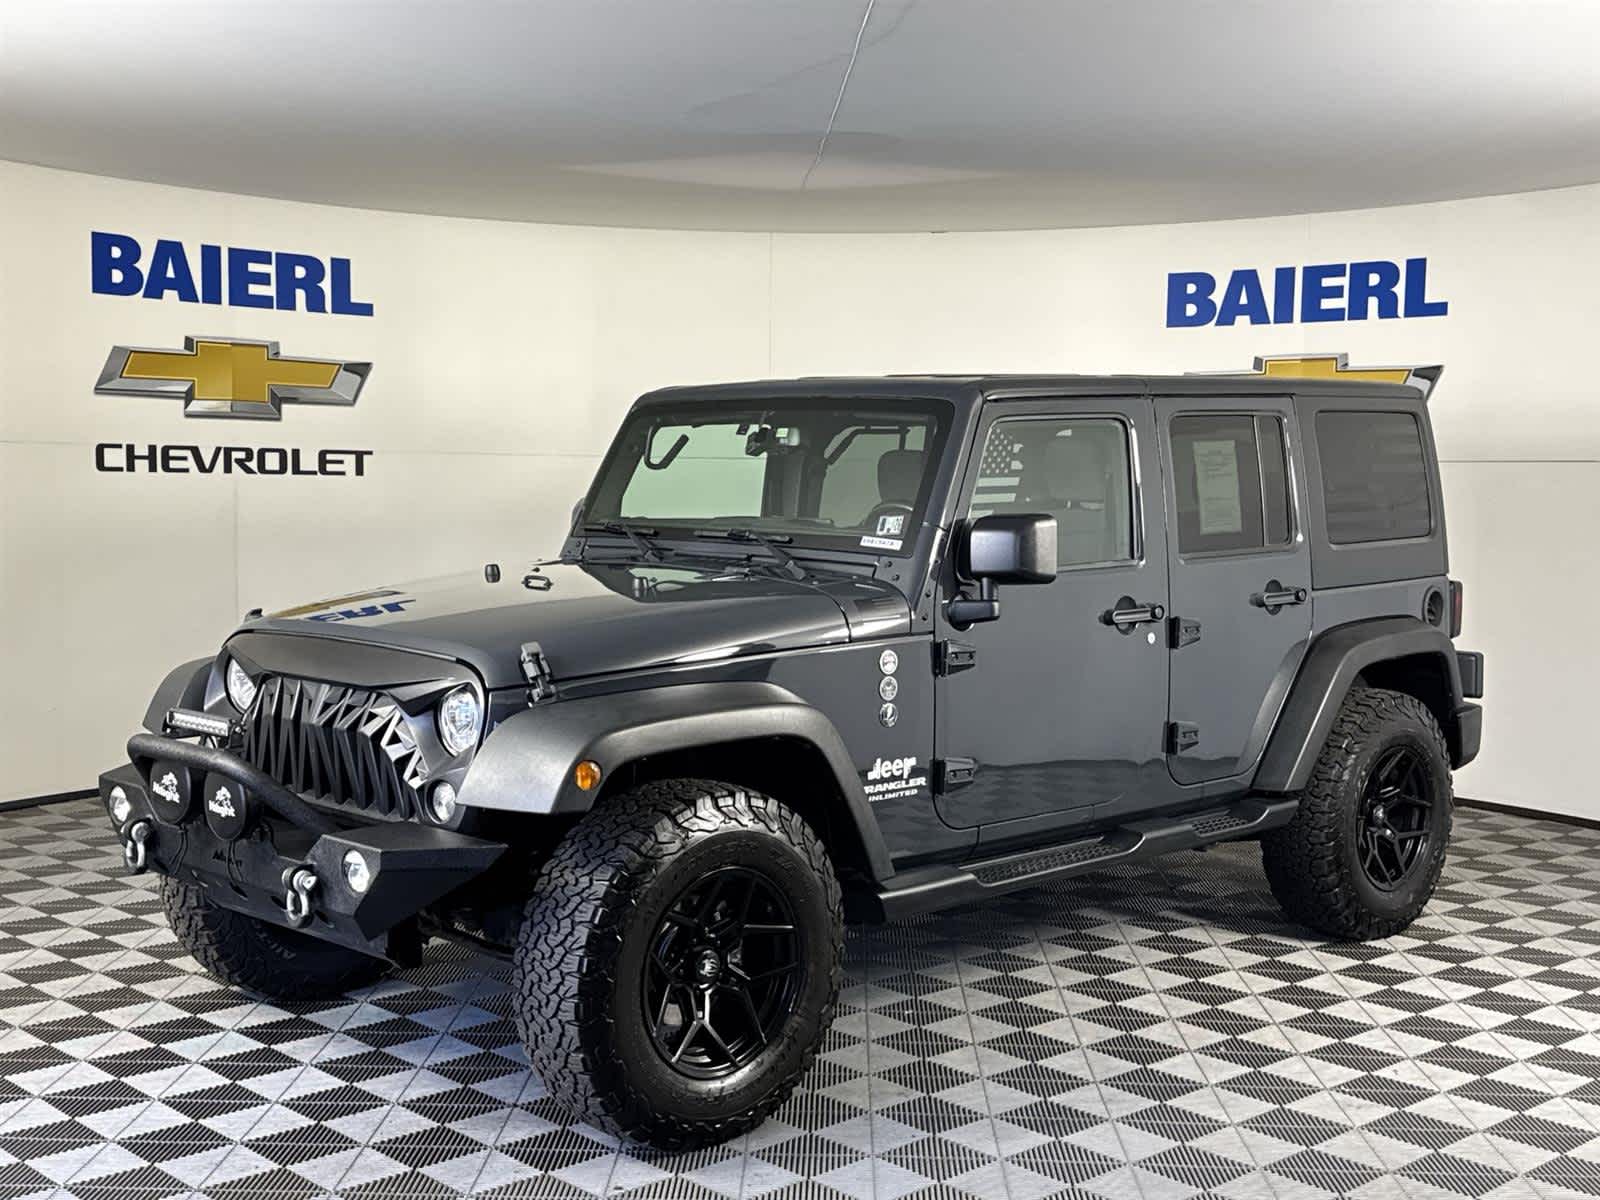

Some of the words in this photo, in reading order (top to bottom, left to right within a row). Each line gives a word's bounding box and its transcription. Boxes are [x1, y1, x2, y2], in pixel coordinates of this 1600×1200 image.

[91, 230, 374, 317] BAIERL
[1165, 257, 1449, 329] BAIERL
[95, 443, 373, 477] CHEVROLET
[863, 776, 927, 795] RANGLER
